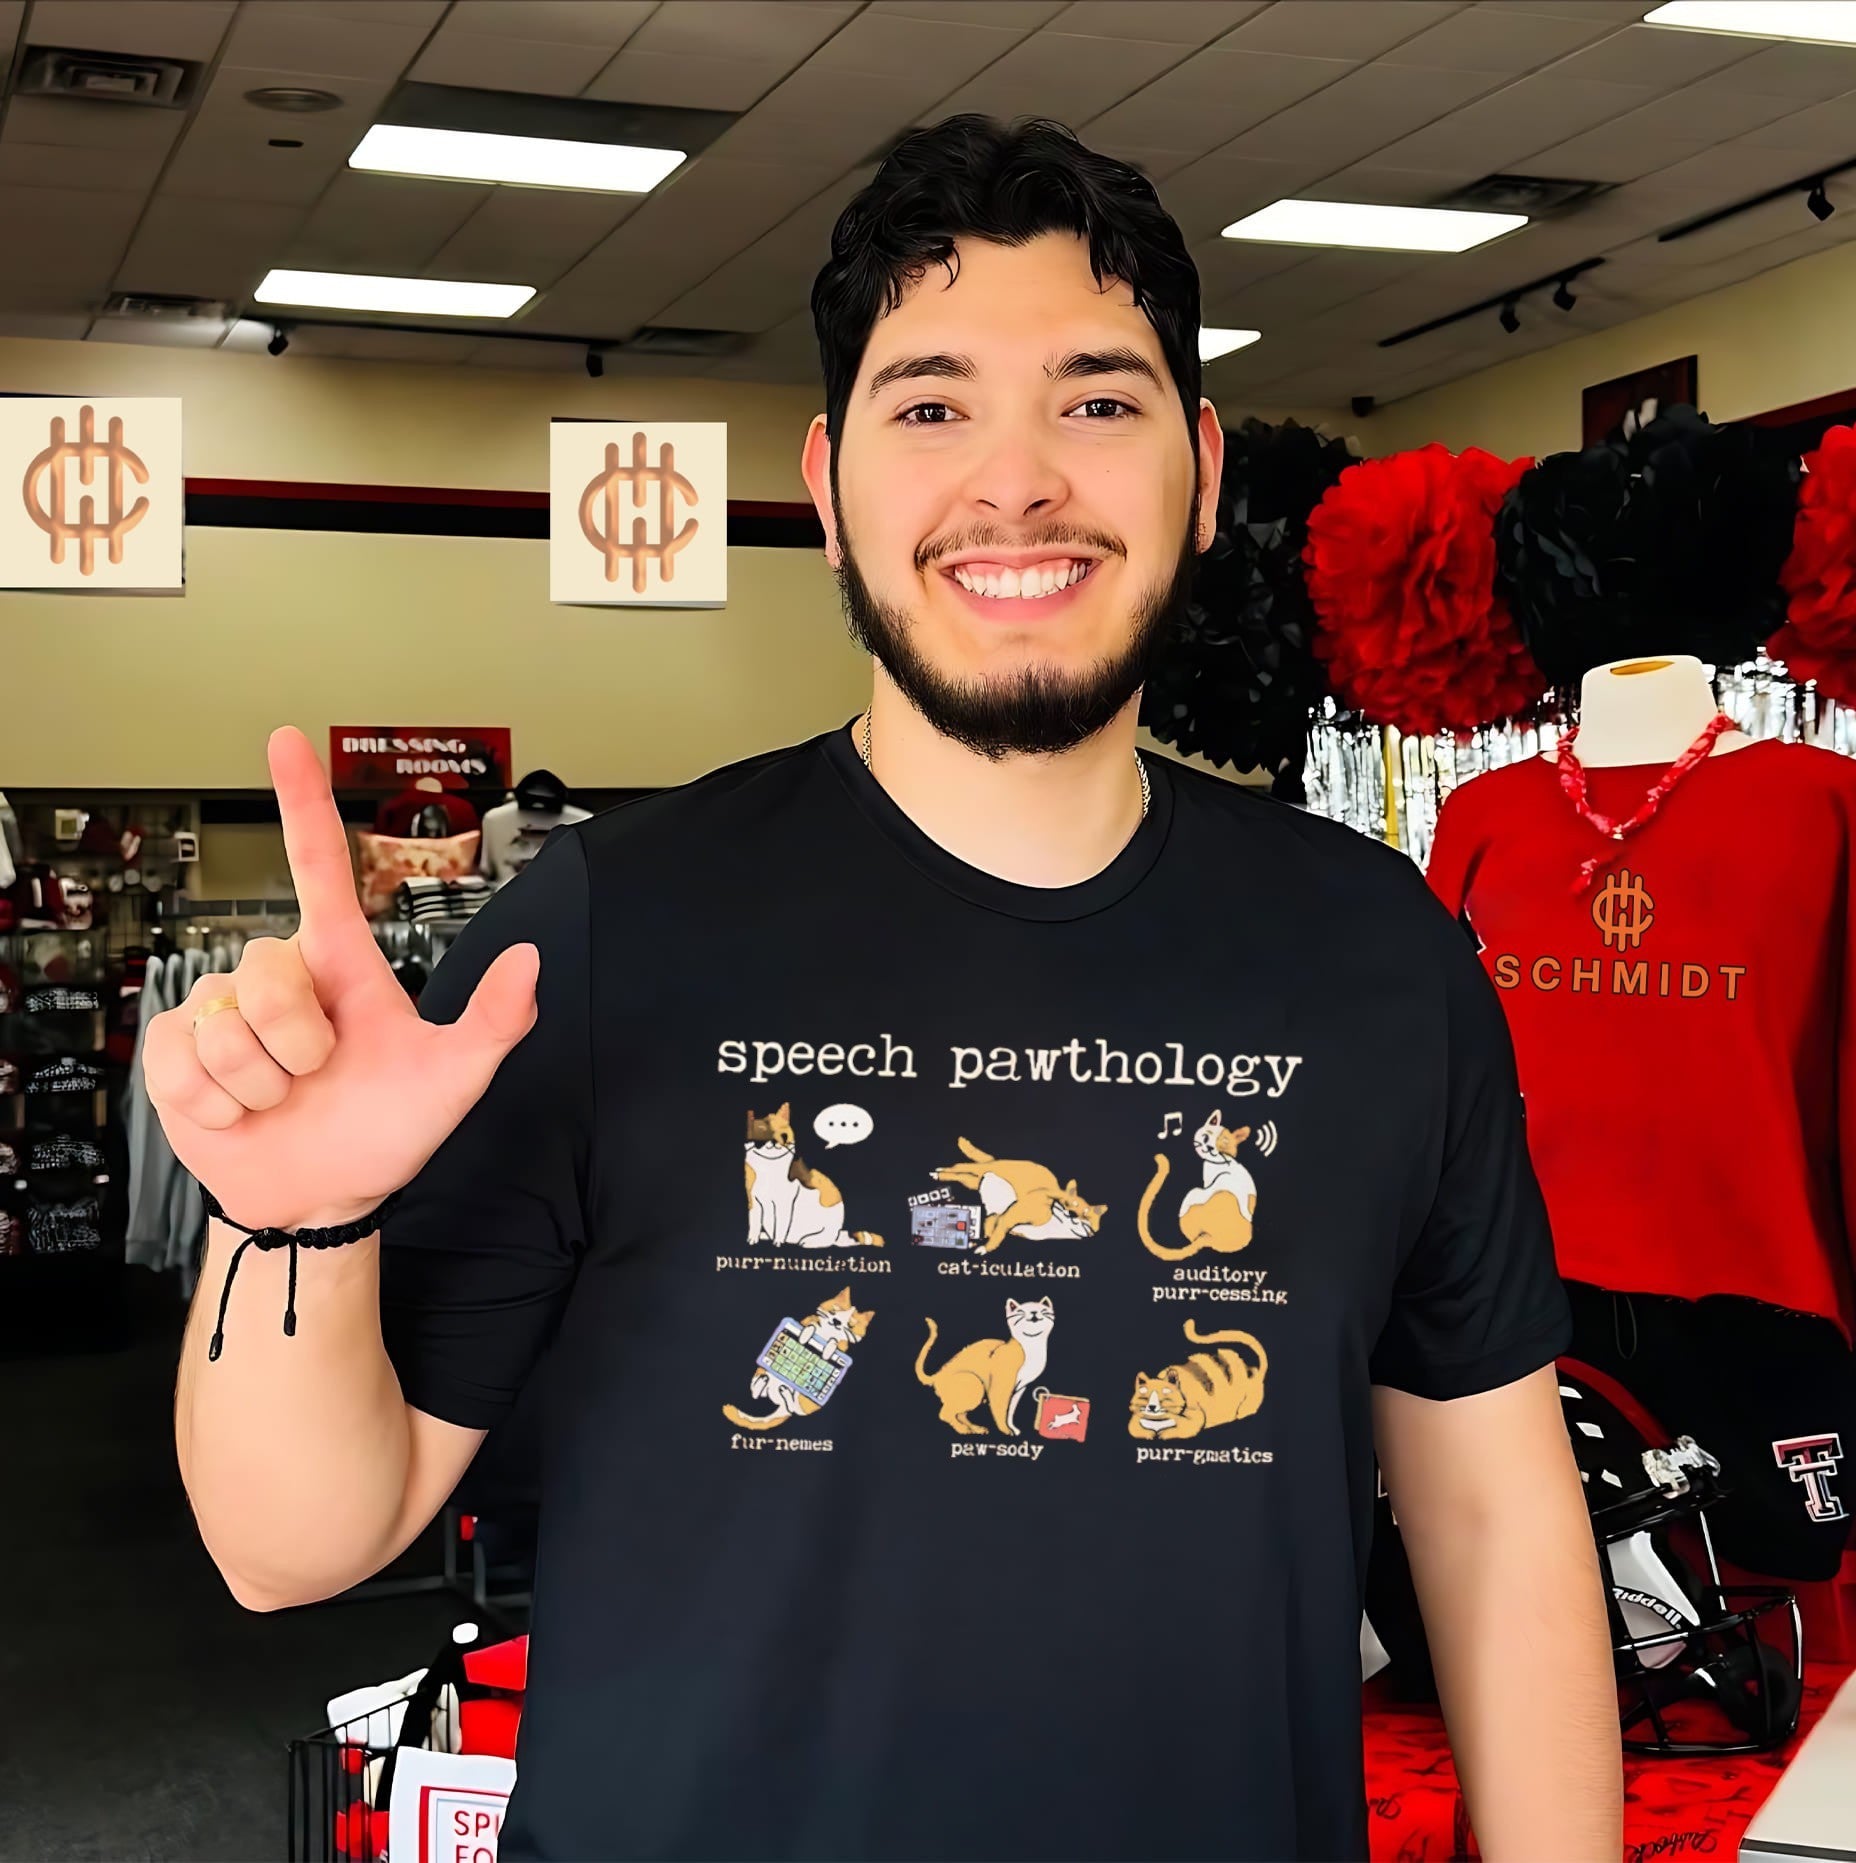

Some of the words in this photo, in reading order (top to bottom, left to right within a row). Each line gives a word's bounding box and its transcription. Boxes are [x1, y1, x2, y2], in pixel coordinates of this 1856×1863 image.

[342, 737, 467, 754] DRESSING
[396, 759, 487, 775] ROOMS
[1494, 954, 1746, 1000] SCHMIDT
[717, 1033, 918, 1083] speech
[948, 1037, 1303, 1098] pawthology
[937, 1259, 1081, 1279] cat-iculation
[1172, 1265, 1268, 1285] auditory
[1151, 1284, 1288, 1305] purr-cessing
[730, 1432, 834, 1452] fur-nemes
[950, 1441, 1045, 1461] paw-sody
[1136, 1446, 1274, 1466] purr-gmatics
